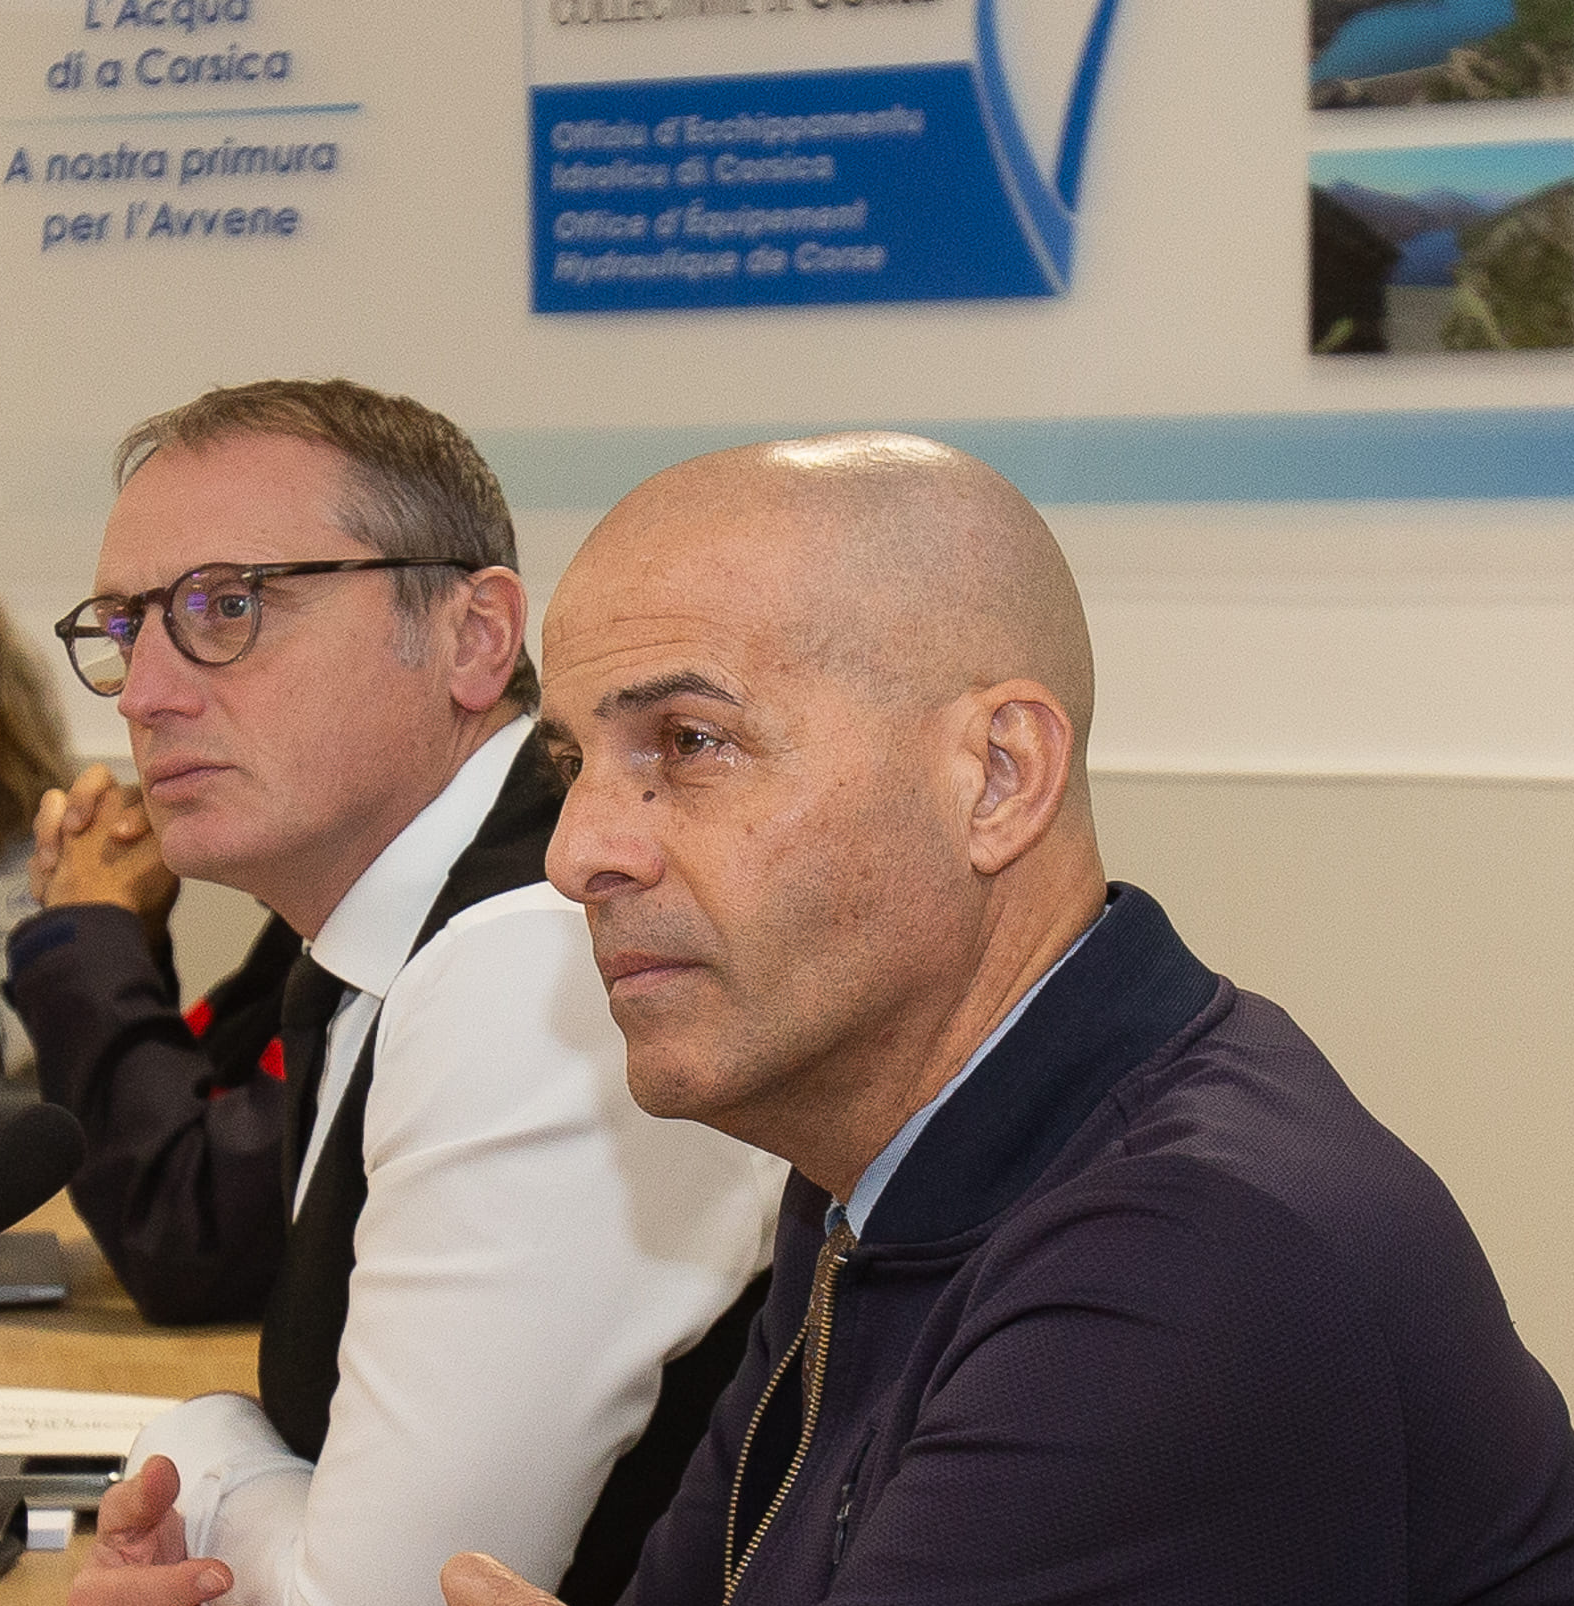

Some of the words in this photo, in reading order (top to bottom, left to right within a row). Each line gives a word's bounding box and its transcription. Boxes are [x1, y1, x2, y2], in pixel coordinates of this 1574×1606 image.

[46, 51, 85, 90] di
[95, 60, 124, 90] a
[136, 43, 292, 86] Corsica
[4, 148, 32, 184] A
[46, 142, 169, 182] nostra
[180, 136, 339, 186] primura
[676, 154, 708, 186] di
[715, 151, 835, 184] Corsica
[42, 211, 113, 253] per
[554, 209, 647, 241] Office
[554, 249, 739, 284] Hydraulique
[745, 246, 788, 276] de
[793, 241, 886, 273] Corse
